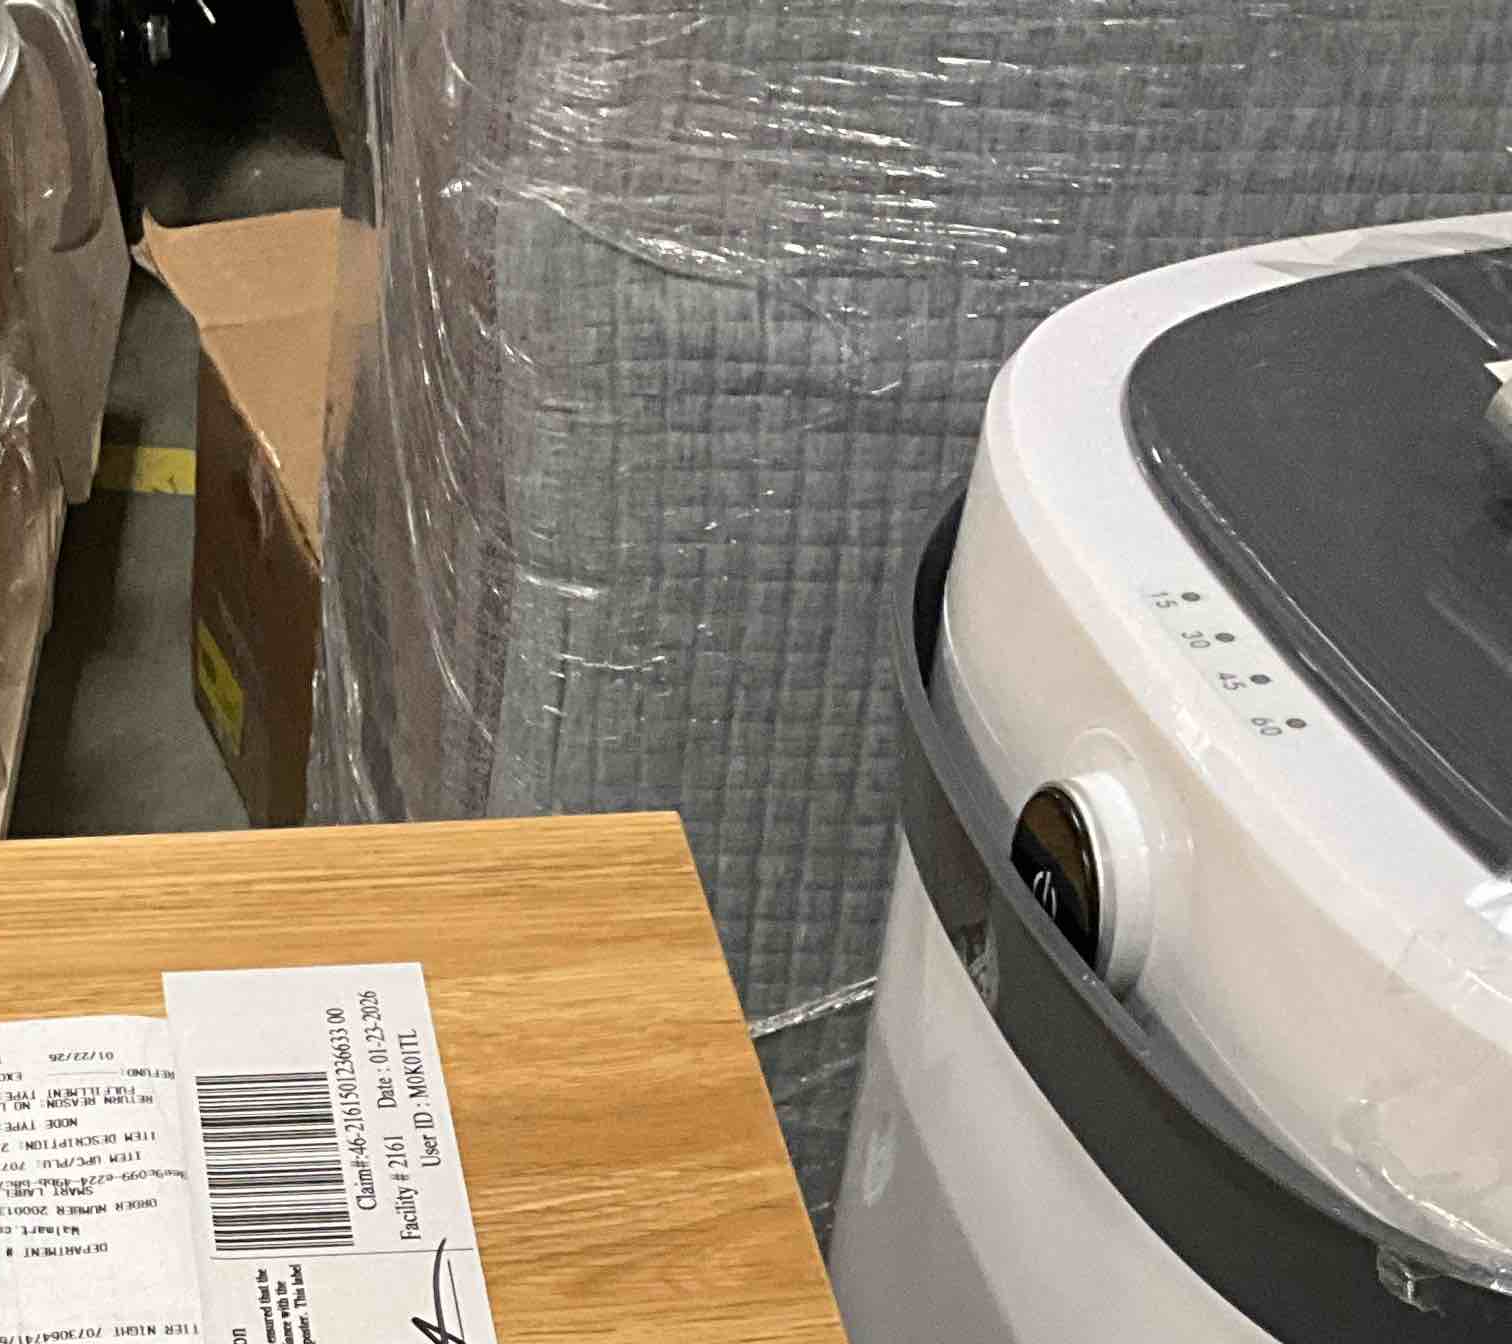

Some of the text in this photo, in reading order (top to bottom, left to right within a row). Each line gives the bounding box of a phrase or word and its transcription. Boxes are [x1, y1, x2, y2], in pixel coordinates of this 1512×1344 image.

[1148, 592, 1178, 608] 15
[1181, 631, 1211, 648] 30
[1218, 672, 1247, 690] 45
[1250, 717, 1283, 736] 60
[326, 1008, 345, 1023] 00
[359, 991, 389, 1063] 01-23-2026
[48, 1086, 135, 1097] FULFILLMENT
[376, 1077, 397, 1108] Date
[14, 1102, 30, 1111] NO
[104, 1095, 152, 1104] RETURN
[46, 1118, 78, 1129] NODE
[413, 1112, 433, 1128] ID
[124, 1132, 155, 1142] ITEM
[1, 1143, 8, 1152] 2
[384, 1136, 408, 1168] 2161
[420, 1135, 441, 1167] User
[110, 1152, 140, 1162] ITEM
[6, 1188, 43, 1198] LABEL
[53, 1186, 93, 1196] SMART
[56, 1204, 106, 1215] NUMBER
[115, 1198, 157, 1211] ORDER
[396, 1187, 421, 1240] Facility
[24, 1243, 108, 1257] DEPARTMENT
[256, 1269, 268, 1283] the
[290, 1264, 303, 1285] label
[258, 1286, 271, 1304] that
[275, 1281, 288, 1295] the
[293, 1288, 307, 1308] This
[278, 1298, 291, 1318] with
[114, 1326, 156, 1337] NIGHT
[165, 1324, 199, 1335] TIER
[261, 1307, 275, 1343] ensured
[298, 1313, 315, 1344] poster.
